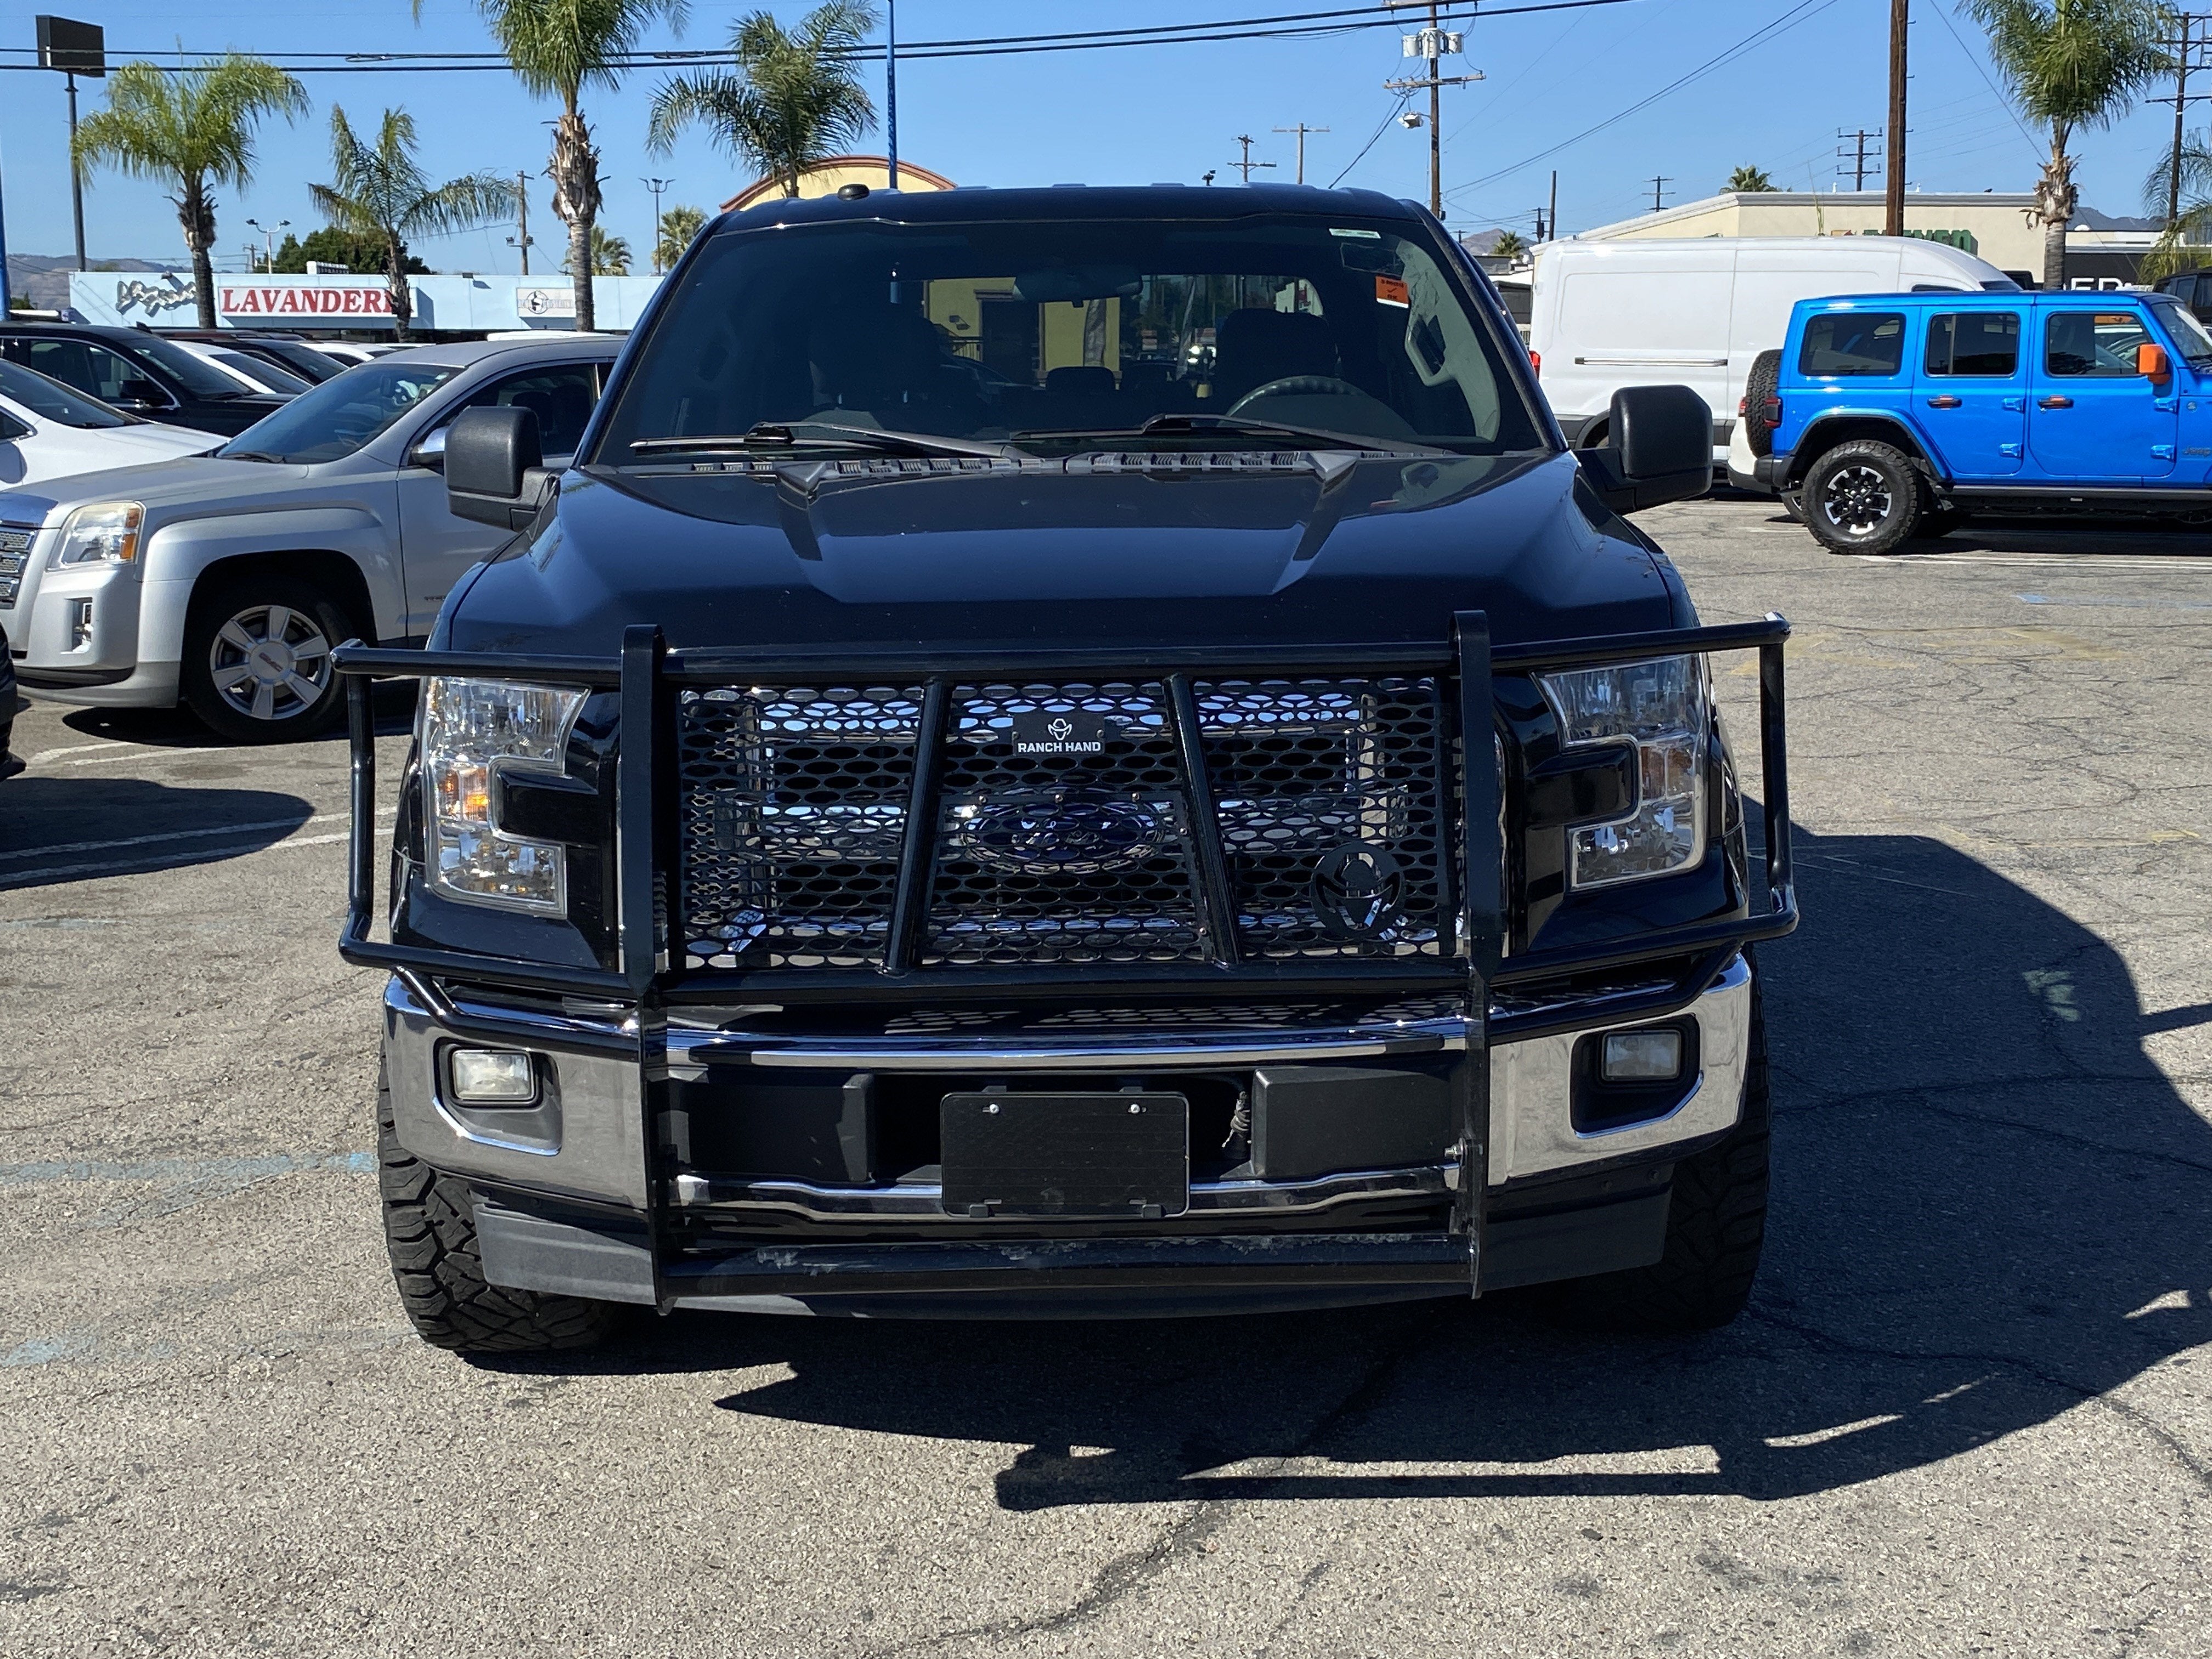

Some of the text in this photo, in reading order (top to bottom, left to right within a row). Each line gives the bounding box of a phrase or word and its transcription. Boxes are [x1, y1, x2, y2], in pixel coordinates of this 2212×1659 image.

[222, 290, 409, 313] LAVANDER
[1018, 741, 1101, 753] RANCH HAND
